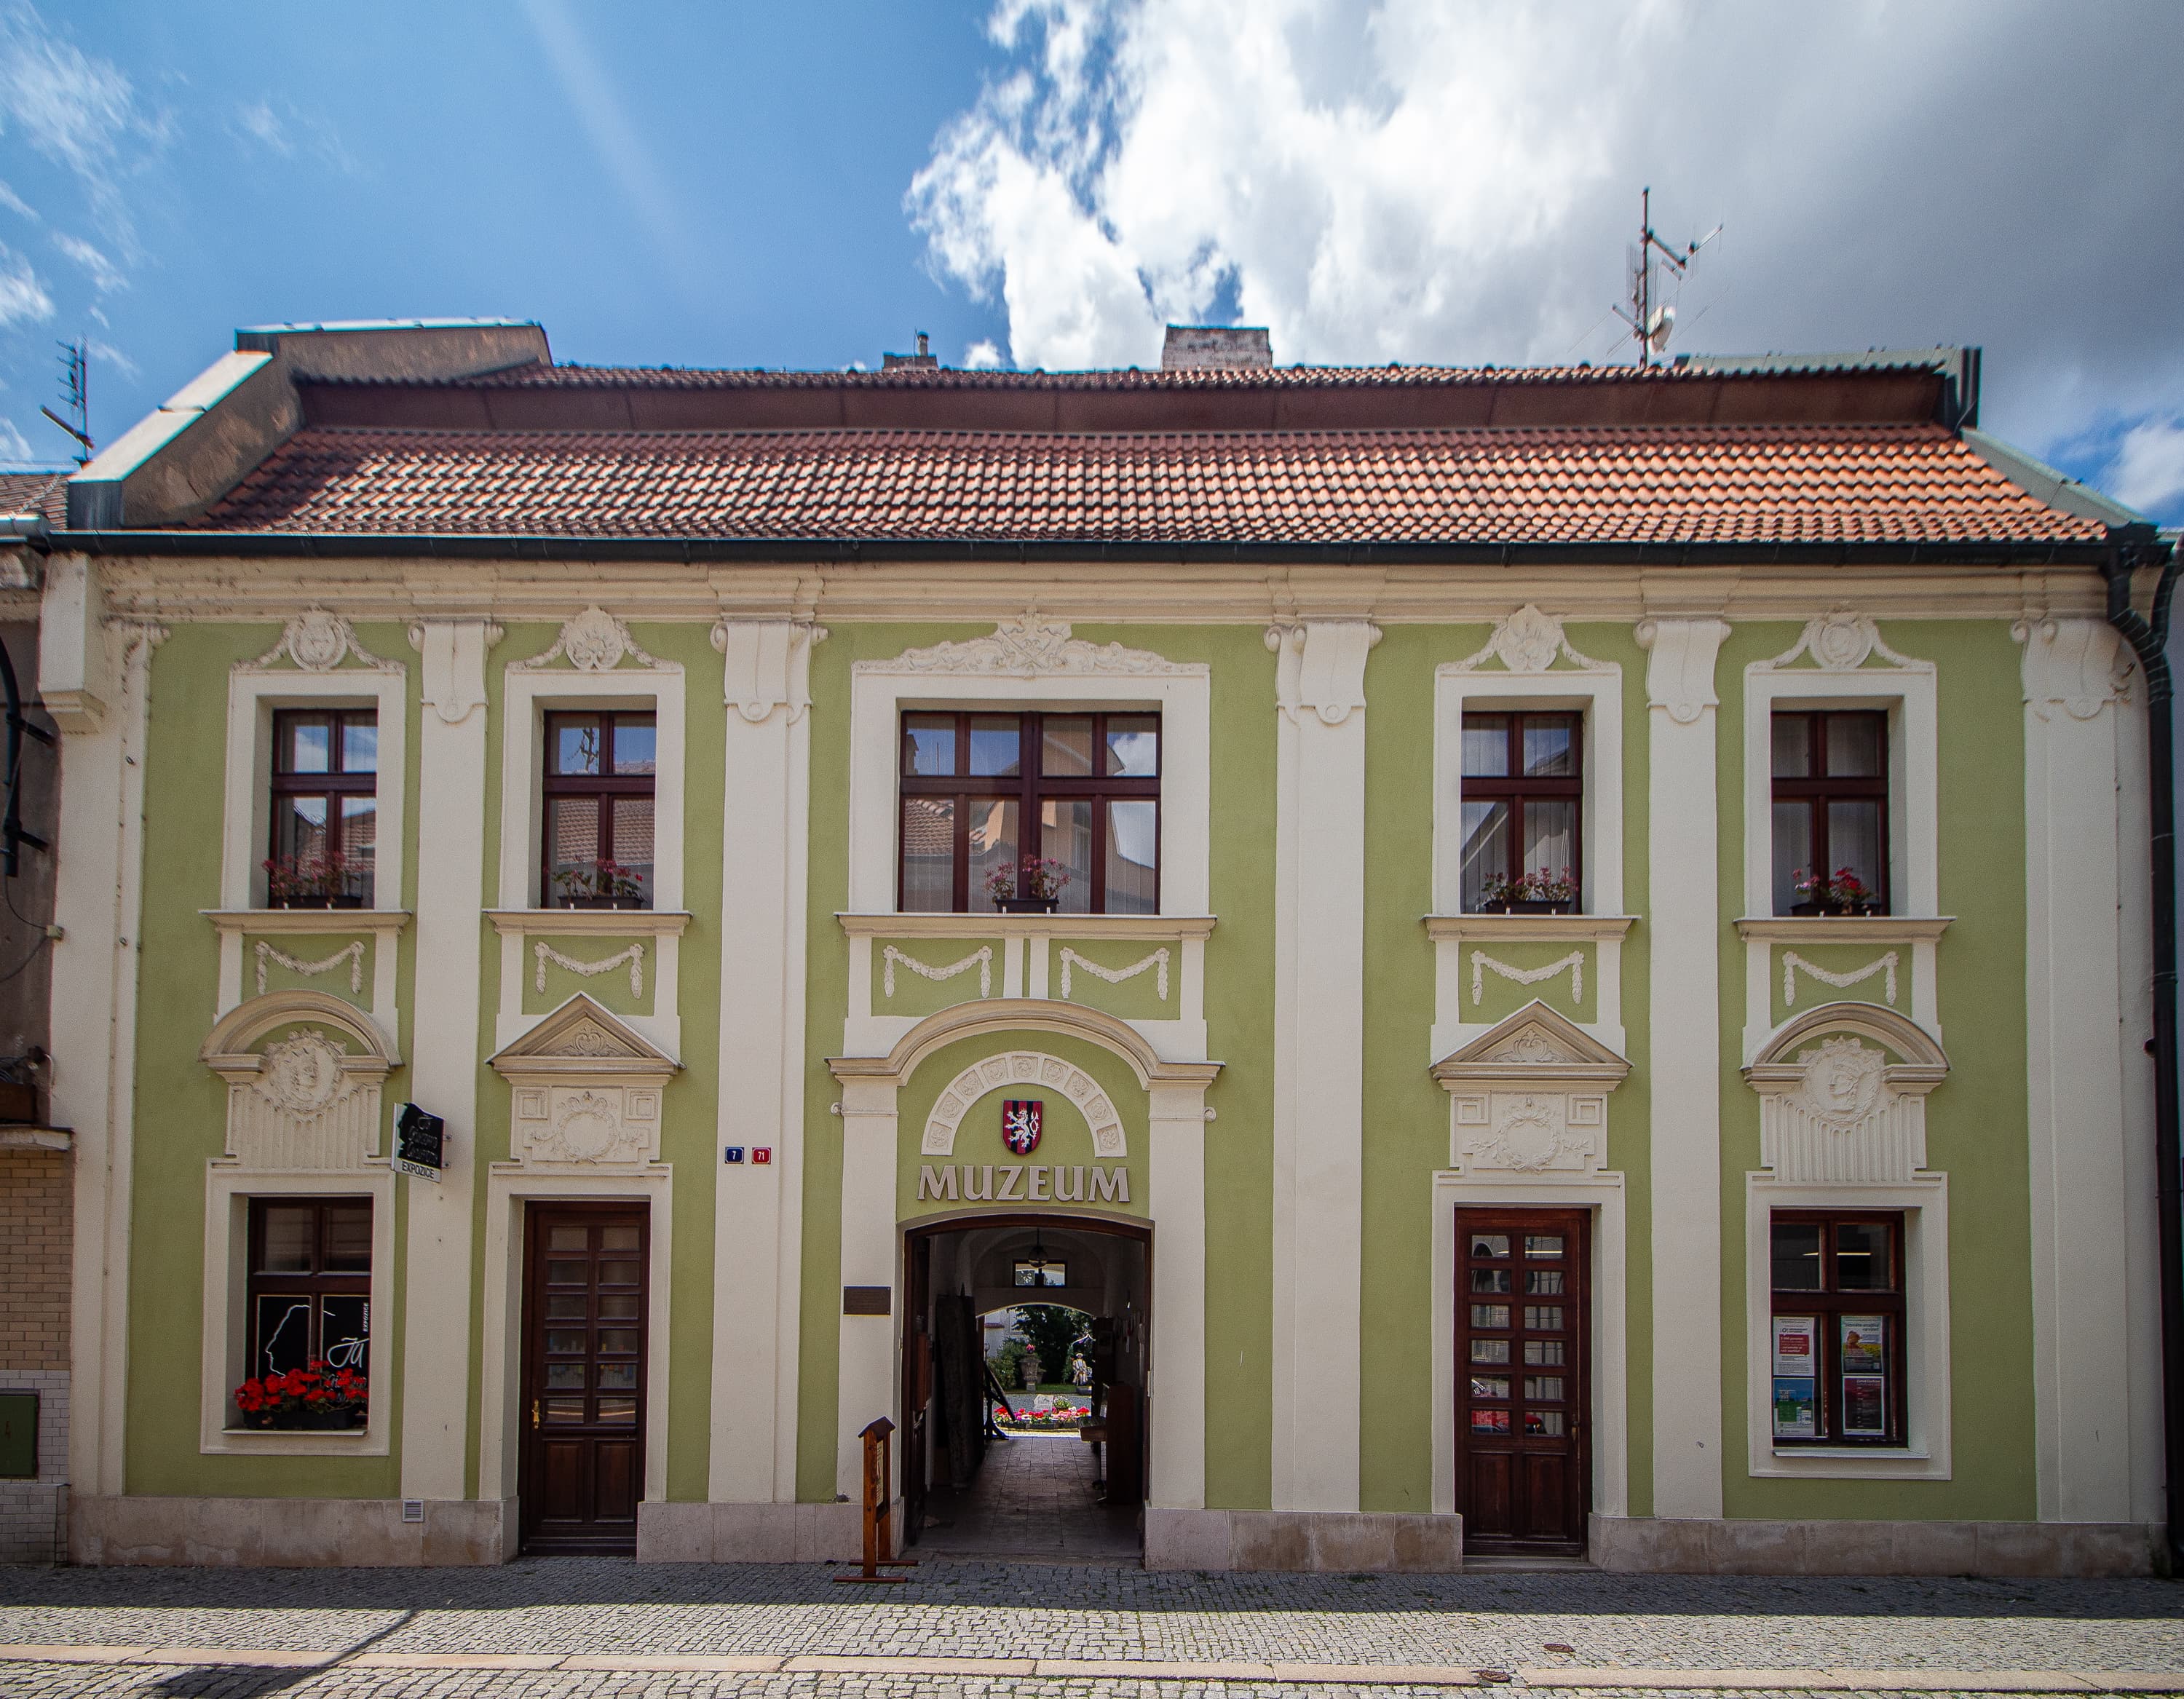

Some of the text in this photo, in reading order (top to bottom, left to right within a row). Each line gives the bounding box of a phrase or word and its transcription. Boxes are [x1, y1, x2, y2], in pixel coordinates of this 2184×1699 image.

[732, 1150, 737, 1160] 7
[757, 1151, 765, 1160] 71
[401, 1160, 435, 1179] EXPOZICE
[917, 1165, 1131, 1203] MUZEUM
